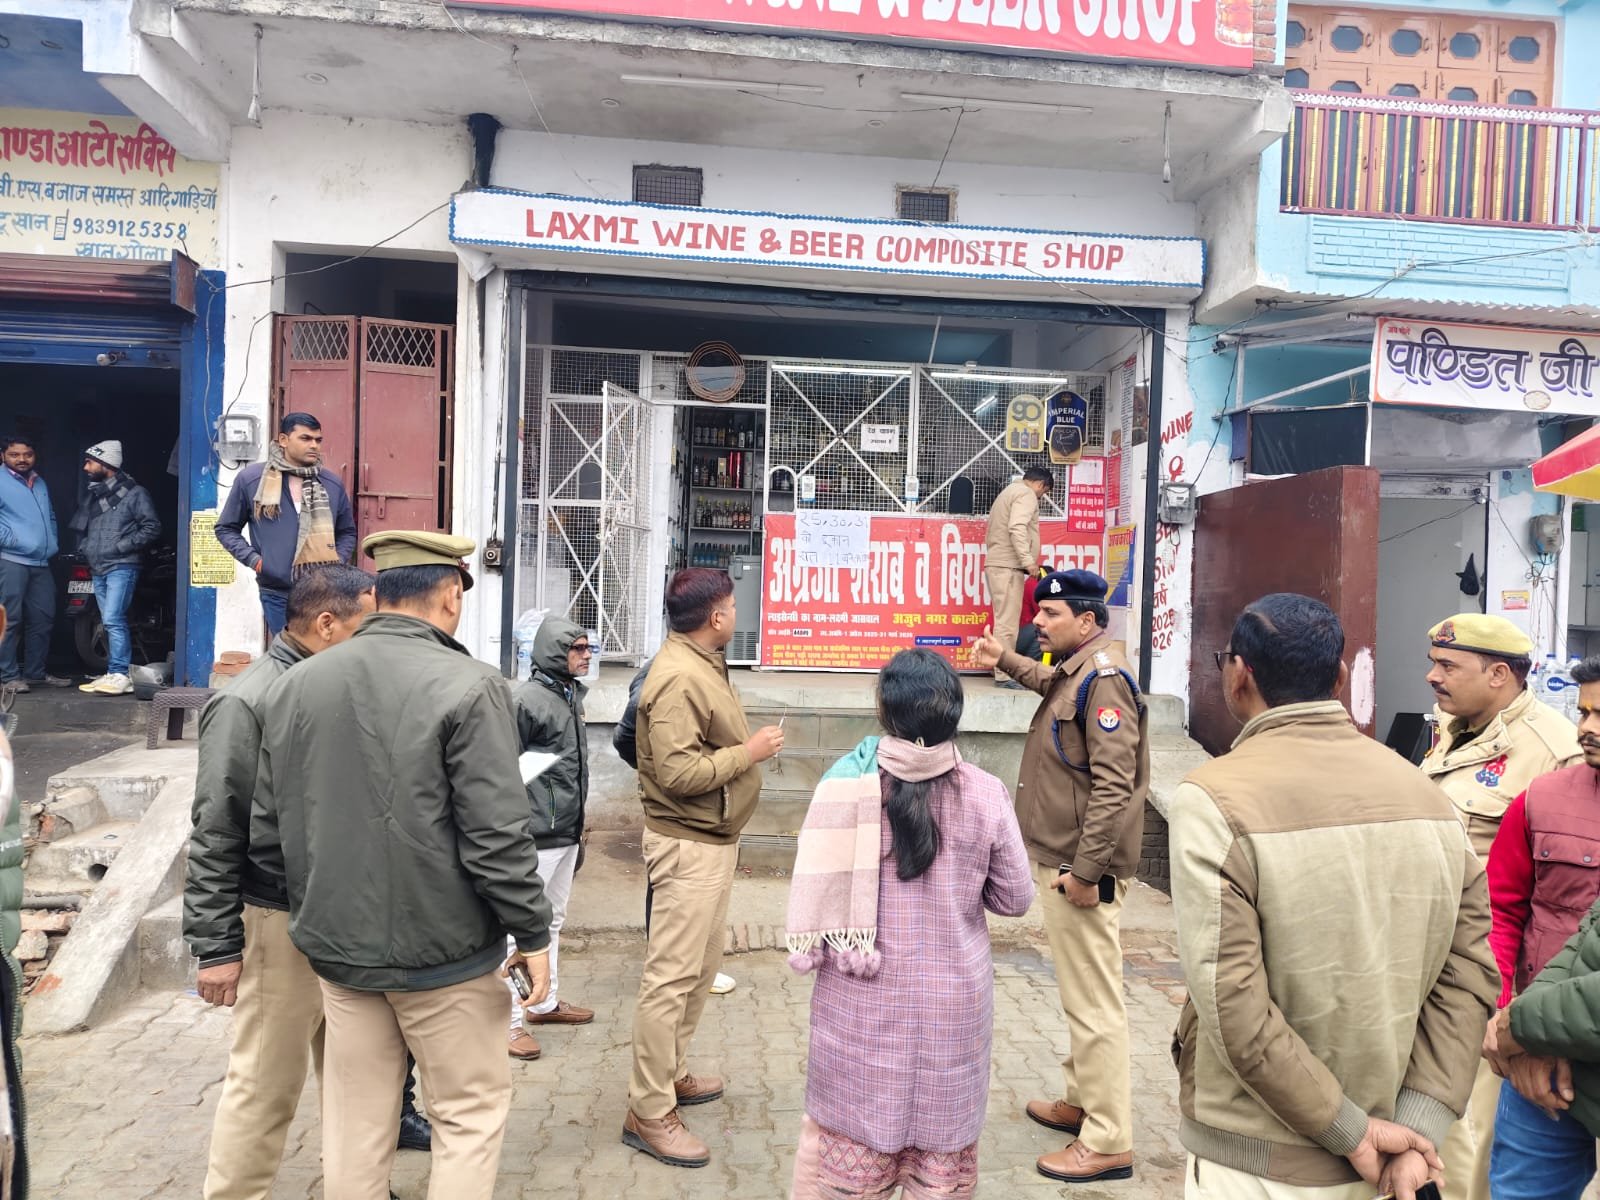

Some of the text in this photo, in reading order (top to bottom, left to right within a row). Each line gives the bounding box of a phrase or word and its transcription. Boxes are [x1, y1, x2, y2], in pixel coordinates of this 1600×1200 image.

[72, 218, 188, 240] 9839125358
[526, 209, 1124, 271] LAXMI WINE & BEER COMPOSITE SHOP
[1386, 328, 1600, 396] पण्डित जी
[1048, 407, 1085, 419] IMPERIAL
[1161, 411, 1193, 444] WINE
[1152, 630, 1173, 650] 026
